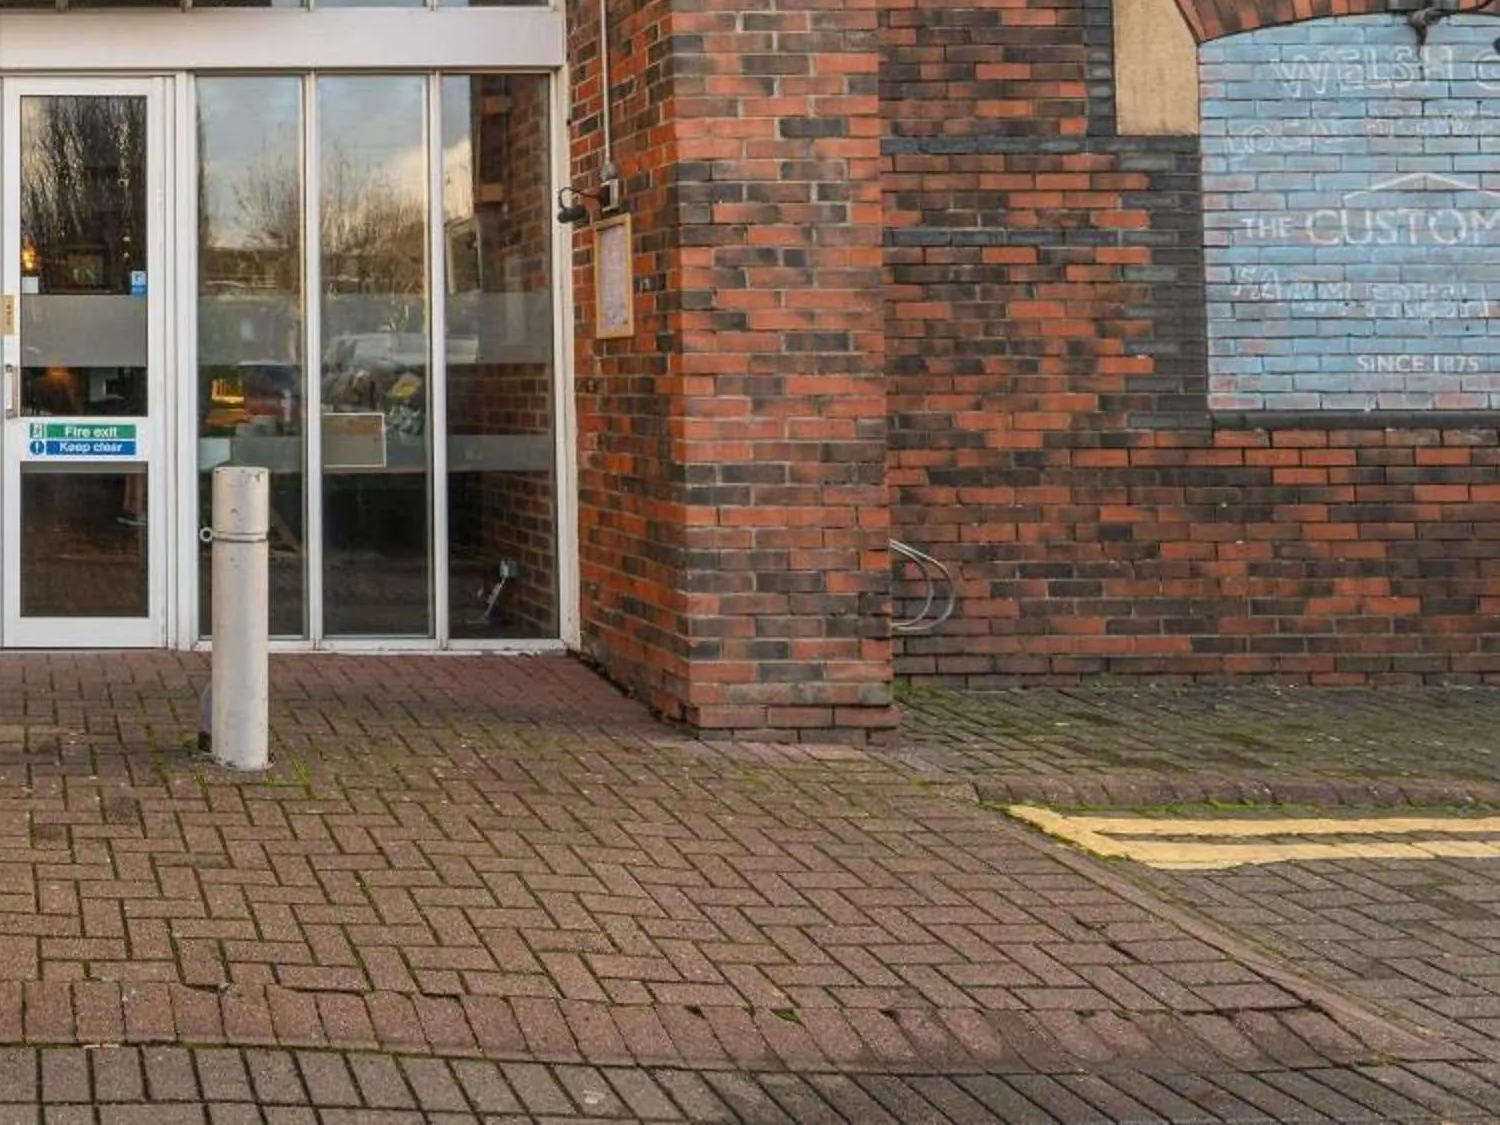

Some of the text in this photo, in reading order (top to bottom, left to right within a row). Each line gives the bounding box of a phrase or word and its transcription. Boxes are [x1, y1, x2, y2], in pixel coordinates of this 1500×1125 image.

[1241, 218, 1294, 239] THE
[1357, 354, 1480, 373] SINCE 1875
[65, 426, 117, 438] Fire exit
[60, 442, 123, 454] Keep clear
